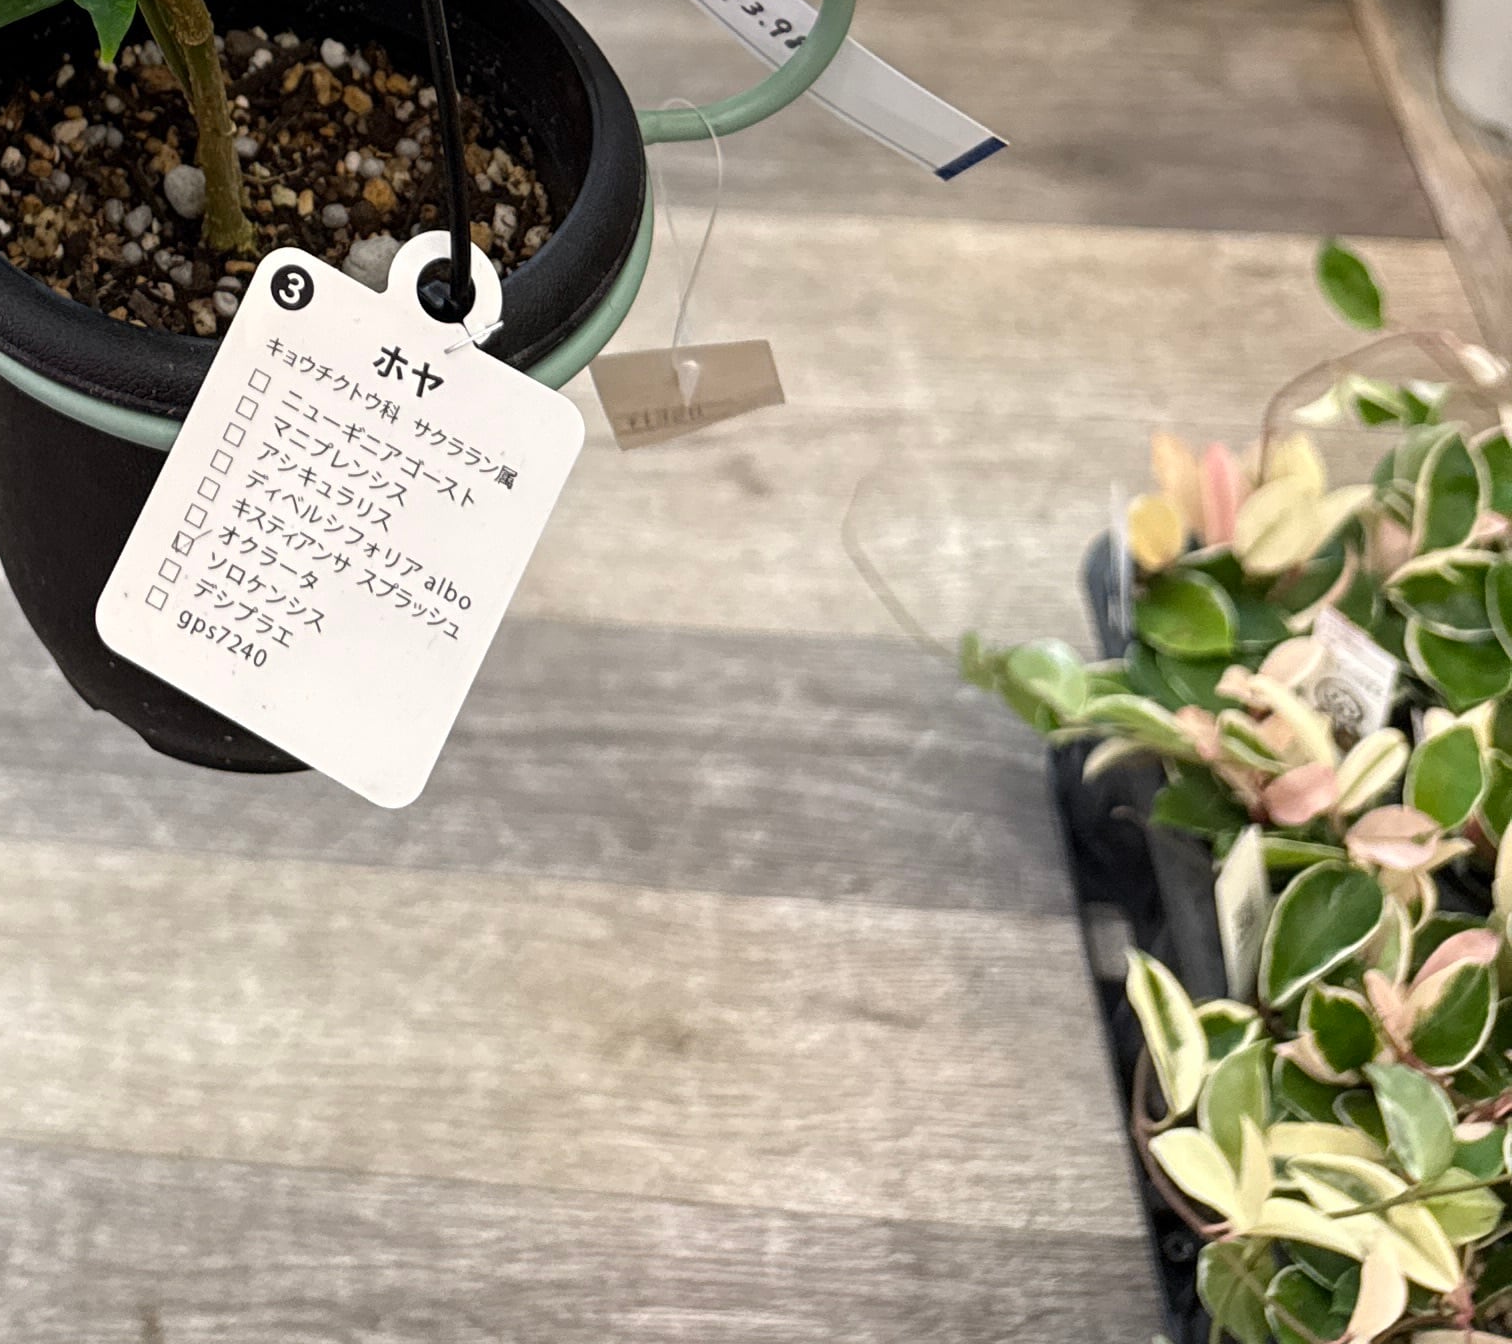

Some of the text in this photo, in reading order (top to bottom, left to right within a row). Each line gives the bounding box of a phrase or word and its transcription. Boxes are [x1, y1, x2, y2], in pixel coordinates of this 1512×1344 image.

[266, 337, 519, 491] キョウチクトウ科 サクララン属
[372, 345, 445, 399] ホヤ
[257, 441, 392, 533] アシキュラリス
[274, 415, 408, 508] マニプレンシス
[281, 389, 475, 508] ニューギニアゴースト
[218, 525, 319, 590] オクラータ
[232, 497, 461, 641] キスティアンサ スプラッシュ
[245, 469, 472, 611] ディベルシフォリア albo
[176, 608, 268, 668] gps7240
[193, 577, 294, 649] デシプラエ
[207, 551, 326, 634] ソロケンシス
